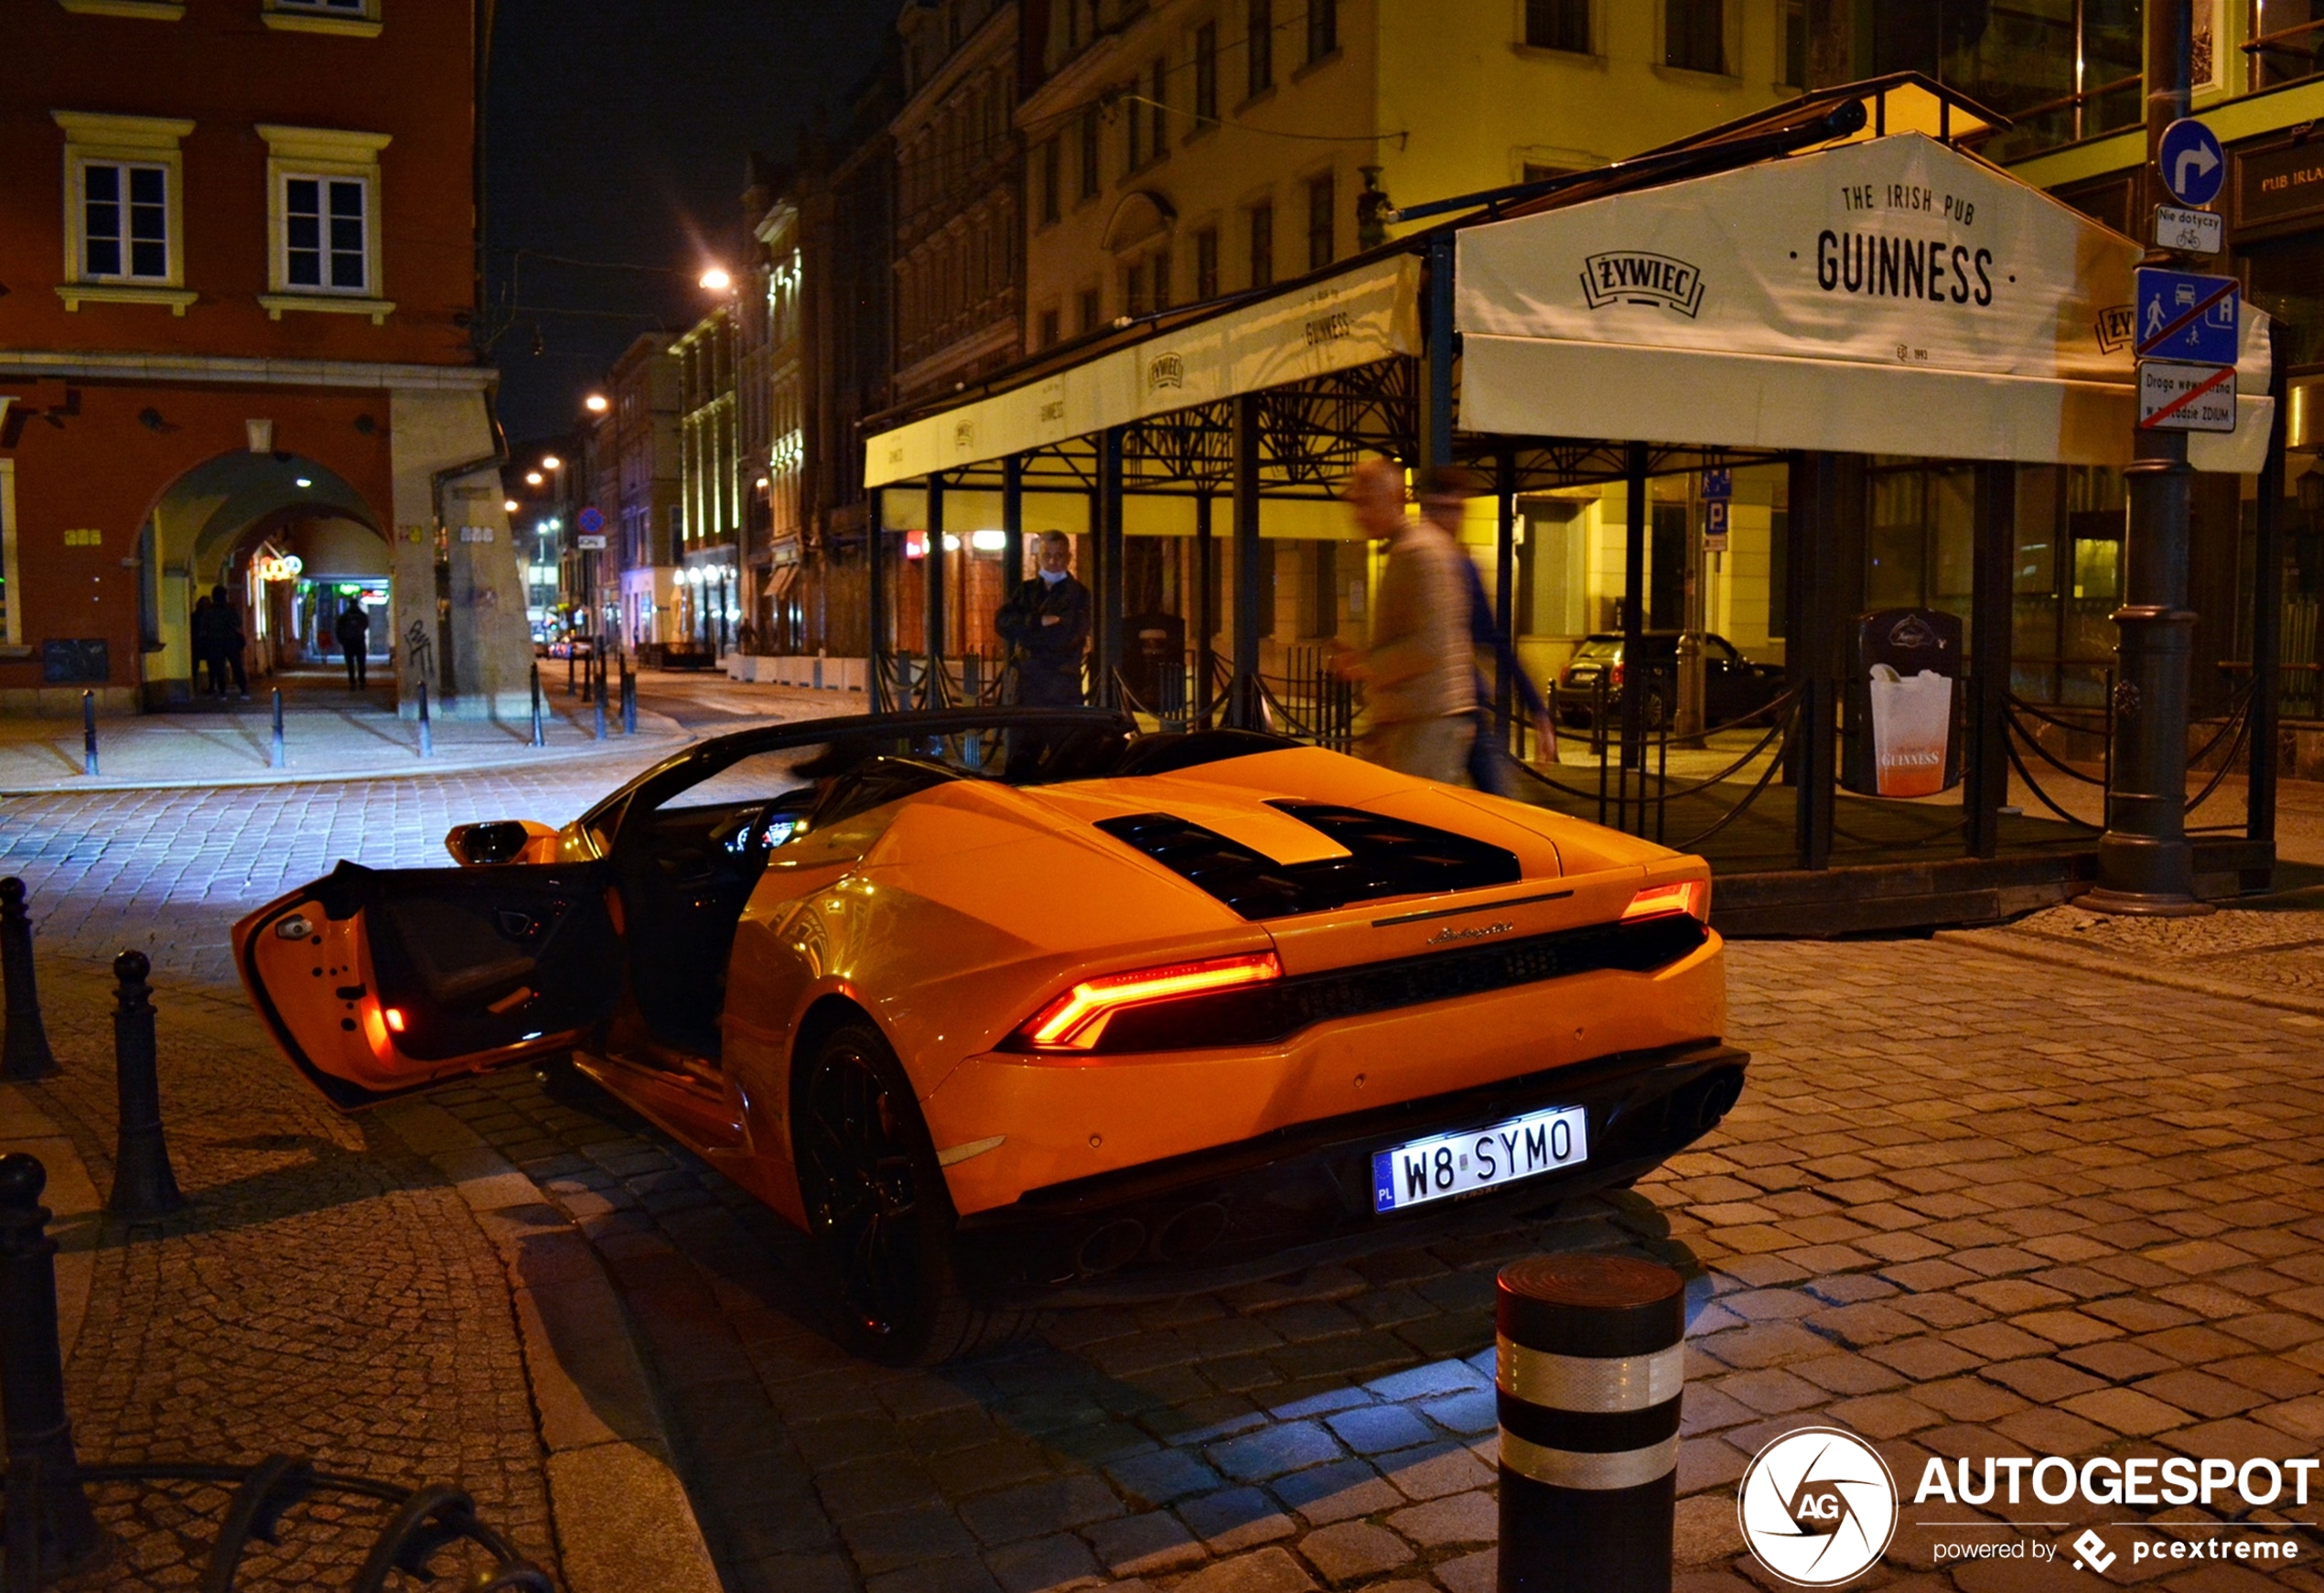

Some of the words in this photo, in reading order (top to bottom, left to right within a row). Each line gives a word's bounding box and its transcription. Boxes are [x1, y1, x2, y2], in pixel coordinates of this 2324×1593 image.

[2262, 175, 2288, 192] PUB
[2293, 167, 2324, 185] IRLA
[1842, 185, 1874, 211] THE
[1888, 185, 1932, 212] IRISH
[1944, 195, 1975, 226] PUB
[2159, 209, 2176, 222] Nie
[2179, 211, 2220, 231] dotyczy
[1598, 257, 1690, 298] ŻYWIEC
[1817, 230, 1993, 307] GUINNESS
[2107, 310, 2136, 338] ŻY
[2146, 373, 2174, 393] Droga
[2202, 406, 2230, 422] ZDIUM
[1709, 502, 1724, 530] P
[1378, 1188, 1393, 1202] PL
[1404, 1146, 1455, 1199] W8
[1475, 1119, 1571, 1180] SYMO
